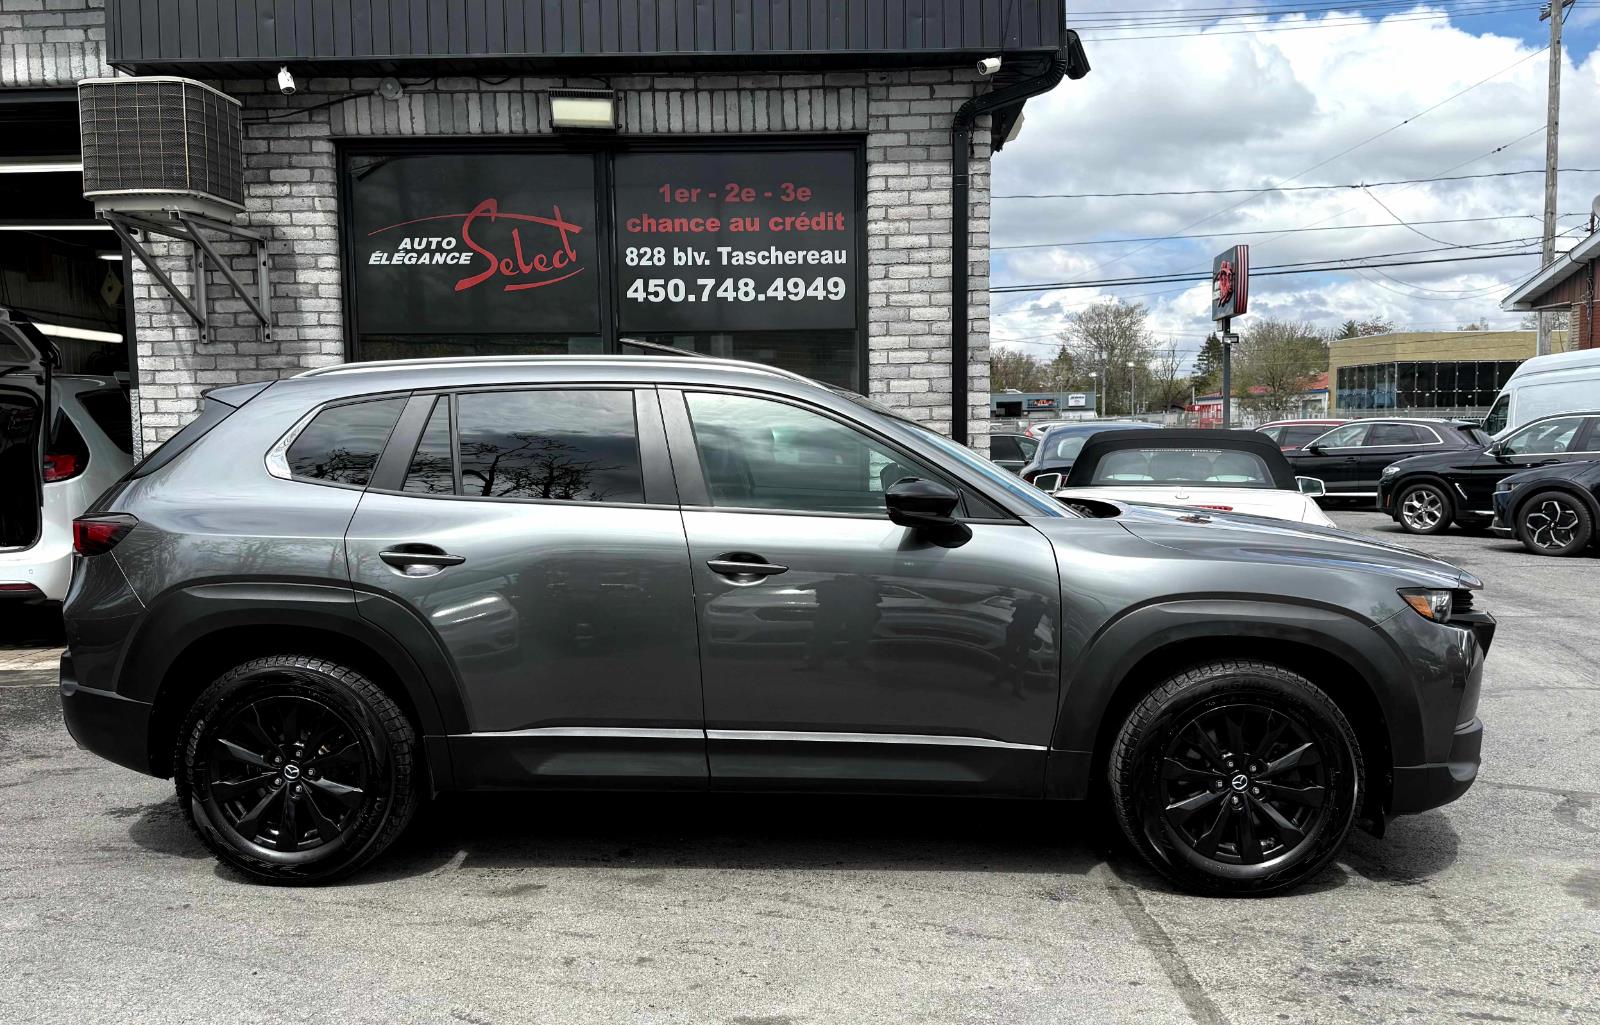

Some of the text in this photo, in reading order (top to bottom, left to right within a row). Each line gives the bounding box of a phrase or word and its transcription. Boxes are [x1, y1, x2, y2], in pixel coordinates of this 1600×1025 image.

[659, 184, 701, 203] 1er
[725, 183, 757, 203] 2e
[780, 182, 812, 201] 3e
[626, 211, 844, 233] chance au crédit
[398, 237, 456, 249] AUTO
[454, 198, 582, 291] Select
[369, 251, 473, 264] ÉLÉGANCE
[626, 246, 846, 266] 828 blv. Taschereau
[627, 277, 845, 302] 450.748.4949
